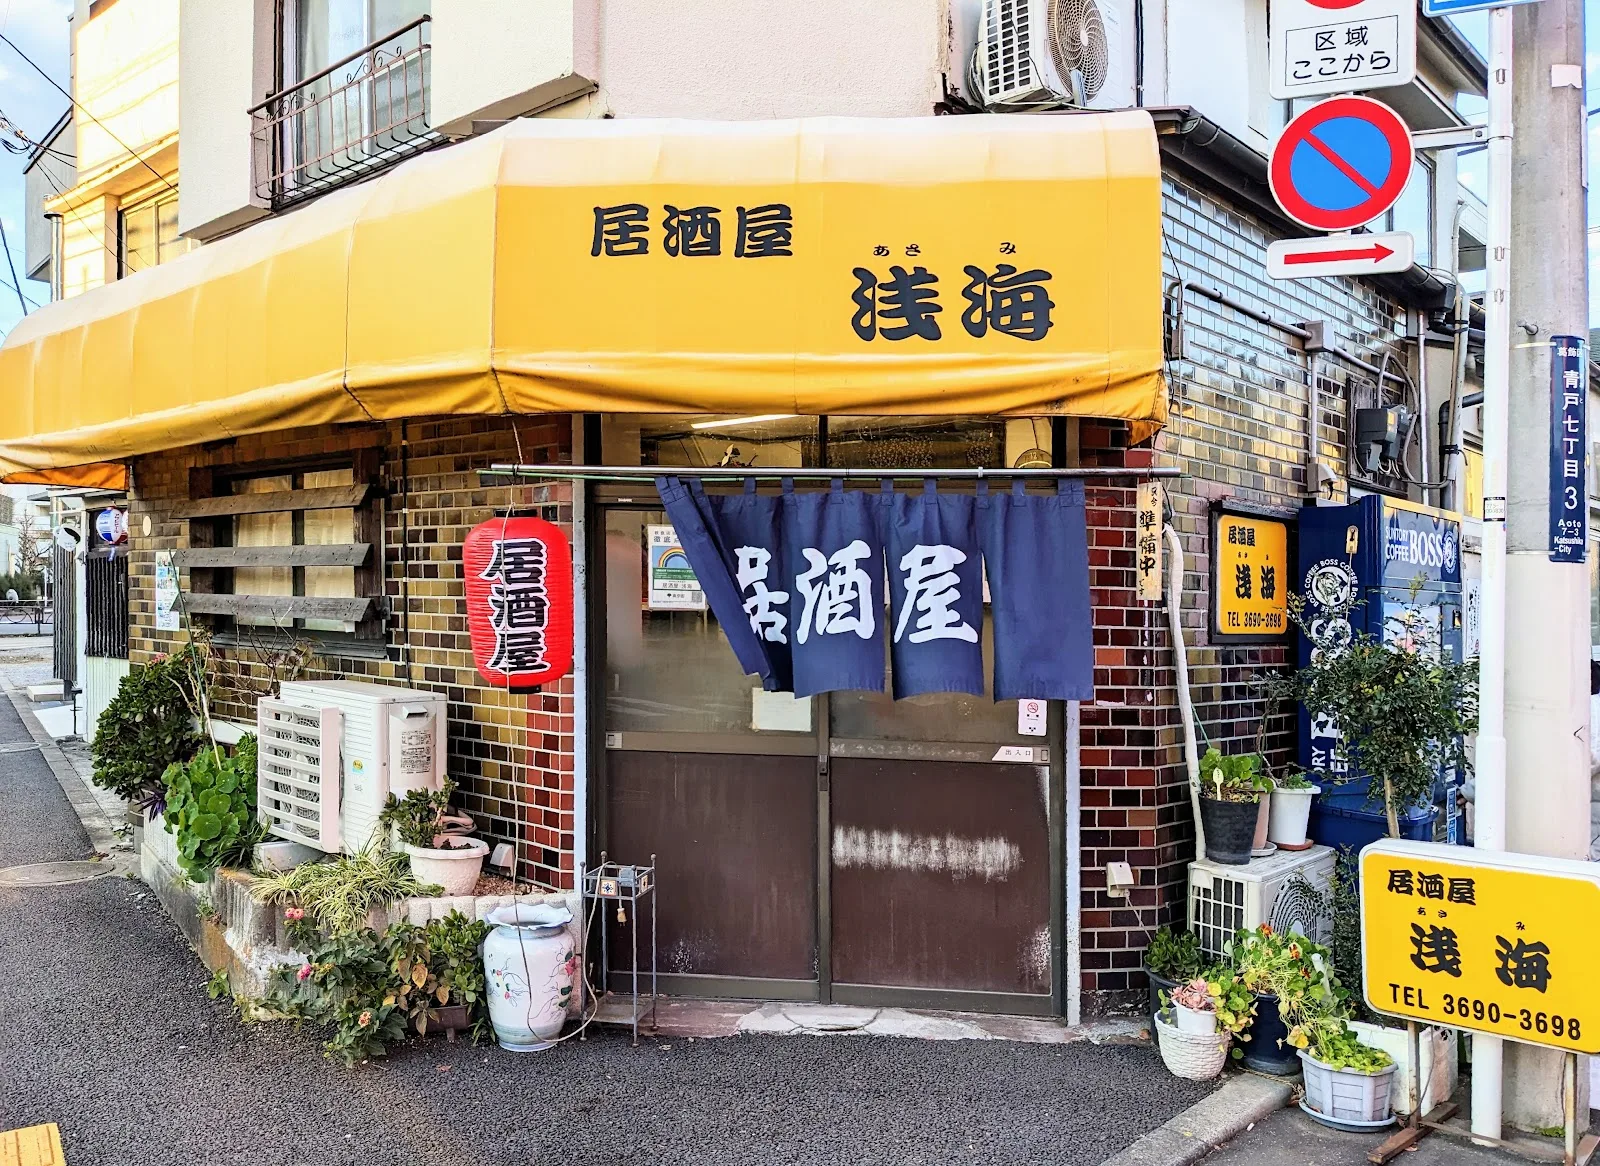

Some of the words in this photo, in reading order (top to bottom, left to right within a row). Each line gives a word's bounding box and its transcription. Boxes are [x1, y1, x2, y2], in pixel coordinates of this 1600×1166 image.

[1315, 25, 1369, 51] 区域
[1293, 51, 1391, 79] ここから
[591, 202, 793, 258] 居酒屋
[851, 264, 1055, 342] 浅海
[1228, 525, 1256, 547] 居酒屋
[1385, 526, 1410, 540] SUNTORY
[1558, 519, 1582, 528] Aoto
[1385, 543, 1410, 561] COFFEE
[1409, 529, 1443, 568] BOSS
[1554, 536, 1584, 545] Katsushika
[1320, 558, 1339, 568] BOSS
[1235, 564, 1276, 600] 浅海
[479, 538, 551, 675] 居酒屋
[1305, 590, 1320, 608] BOSS
[1227, 611, 1241, 627] TEL
[1243, 612, 1282, 628] 3690-3698
[1387, 869, 1476, 906] 居酒屋
[1410, 922, 1552, 994] 浅海
[1389, 983, 1430, 1010] TEL
[1443, 993, 1581, 1041] 3690-3698
